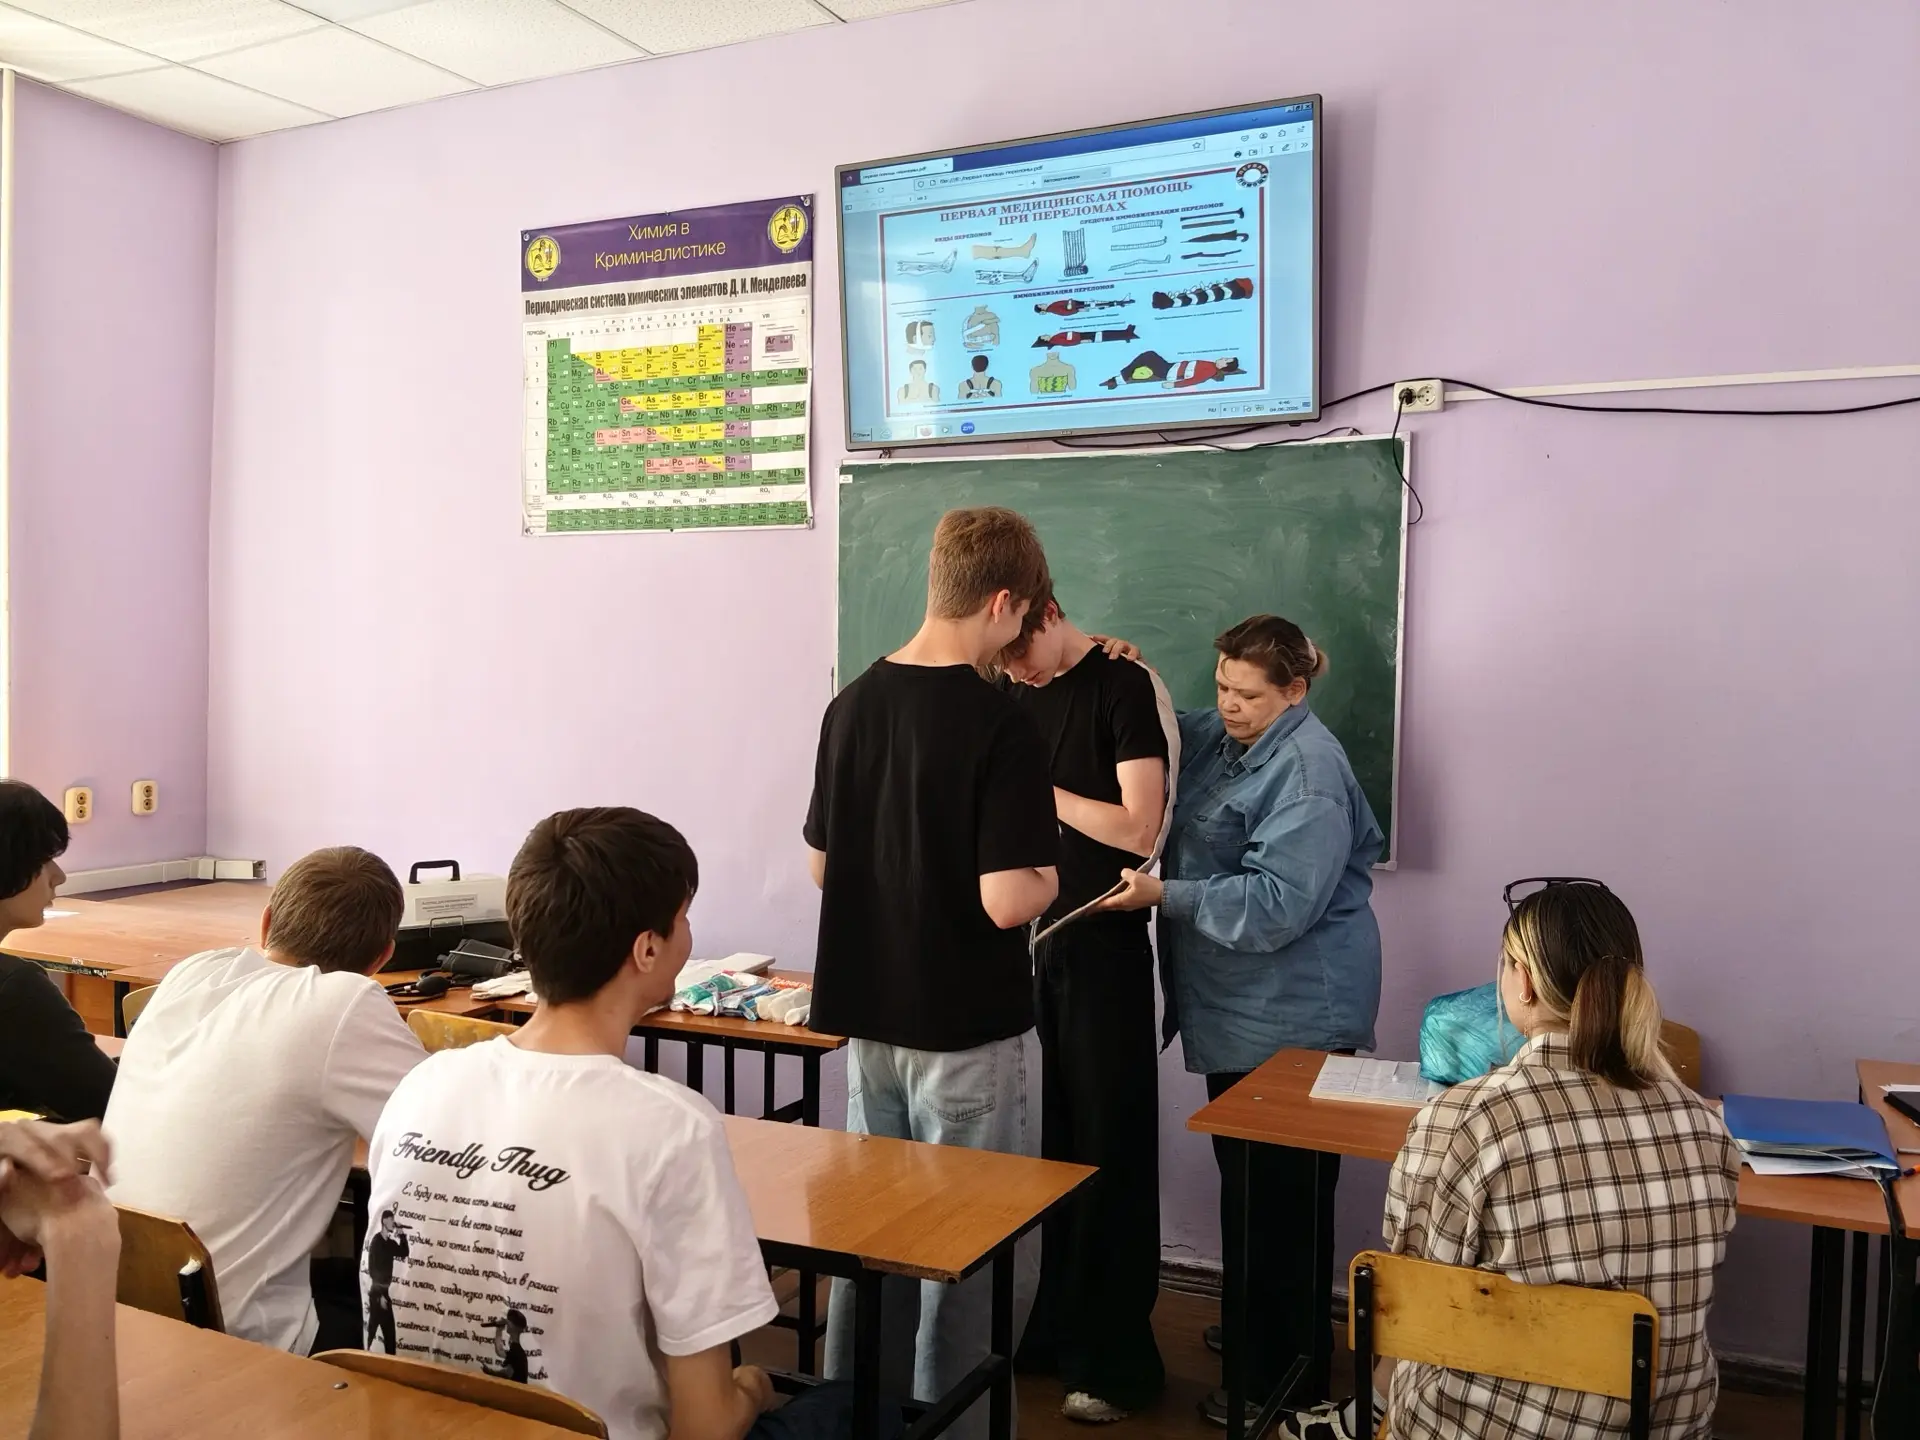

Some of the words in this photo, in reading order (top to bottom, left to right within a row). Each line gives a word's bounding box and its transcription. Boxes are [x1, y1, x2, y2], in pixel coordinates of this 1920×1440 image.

[940, 207, 996, 222] ПЕРВАЯ
[1000, 190, 1117, 214] МЕДИЦИНСКАЯ
[1120, 181, 1193, 198] ПОМОЩЬ
[1181, 202, 1224, 212] ПЕРЕЛОМОВ
[999, 213, 1028, 226] ПРИ
[1033, 201, 1128, 221] ПЕРЕЛОМАХ
[629, 224, 677, 241] Химия
[681, 223, 690, 235] в
[595, 241, 726, 271] Криминалистике
[525, 295, 588, 316] Периодическая
[590, 292, 626, 309] система
[627, 287, 679, 306] химических
[680, 282, 728, 300] элементов
[729, 278, 739, 297] Д.
[741, 278, 749, 294] И.
[750, 273, 807, 294] Менделеева
[393, 1131, 489, 1179] Friendly
[490, 1146, 572, 1191] Thug
[414, 1184, 432, 1202] буду
[433, 1194, 448, 1203] юн,
[490, 1201, 516, 1212] мама
[398, 1209, 426, 1222] спокоен
[448, 1218, 459, 1227] на
[436, 1239, 447, 1247] но
[472, 1240, 495, 1255] быть
[519, 1273, 529, 1286] в
[527, 1280, 559, 1294] ранах
[529, 1303, 553, 1314] хайп
